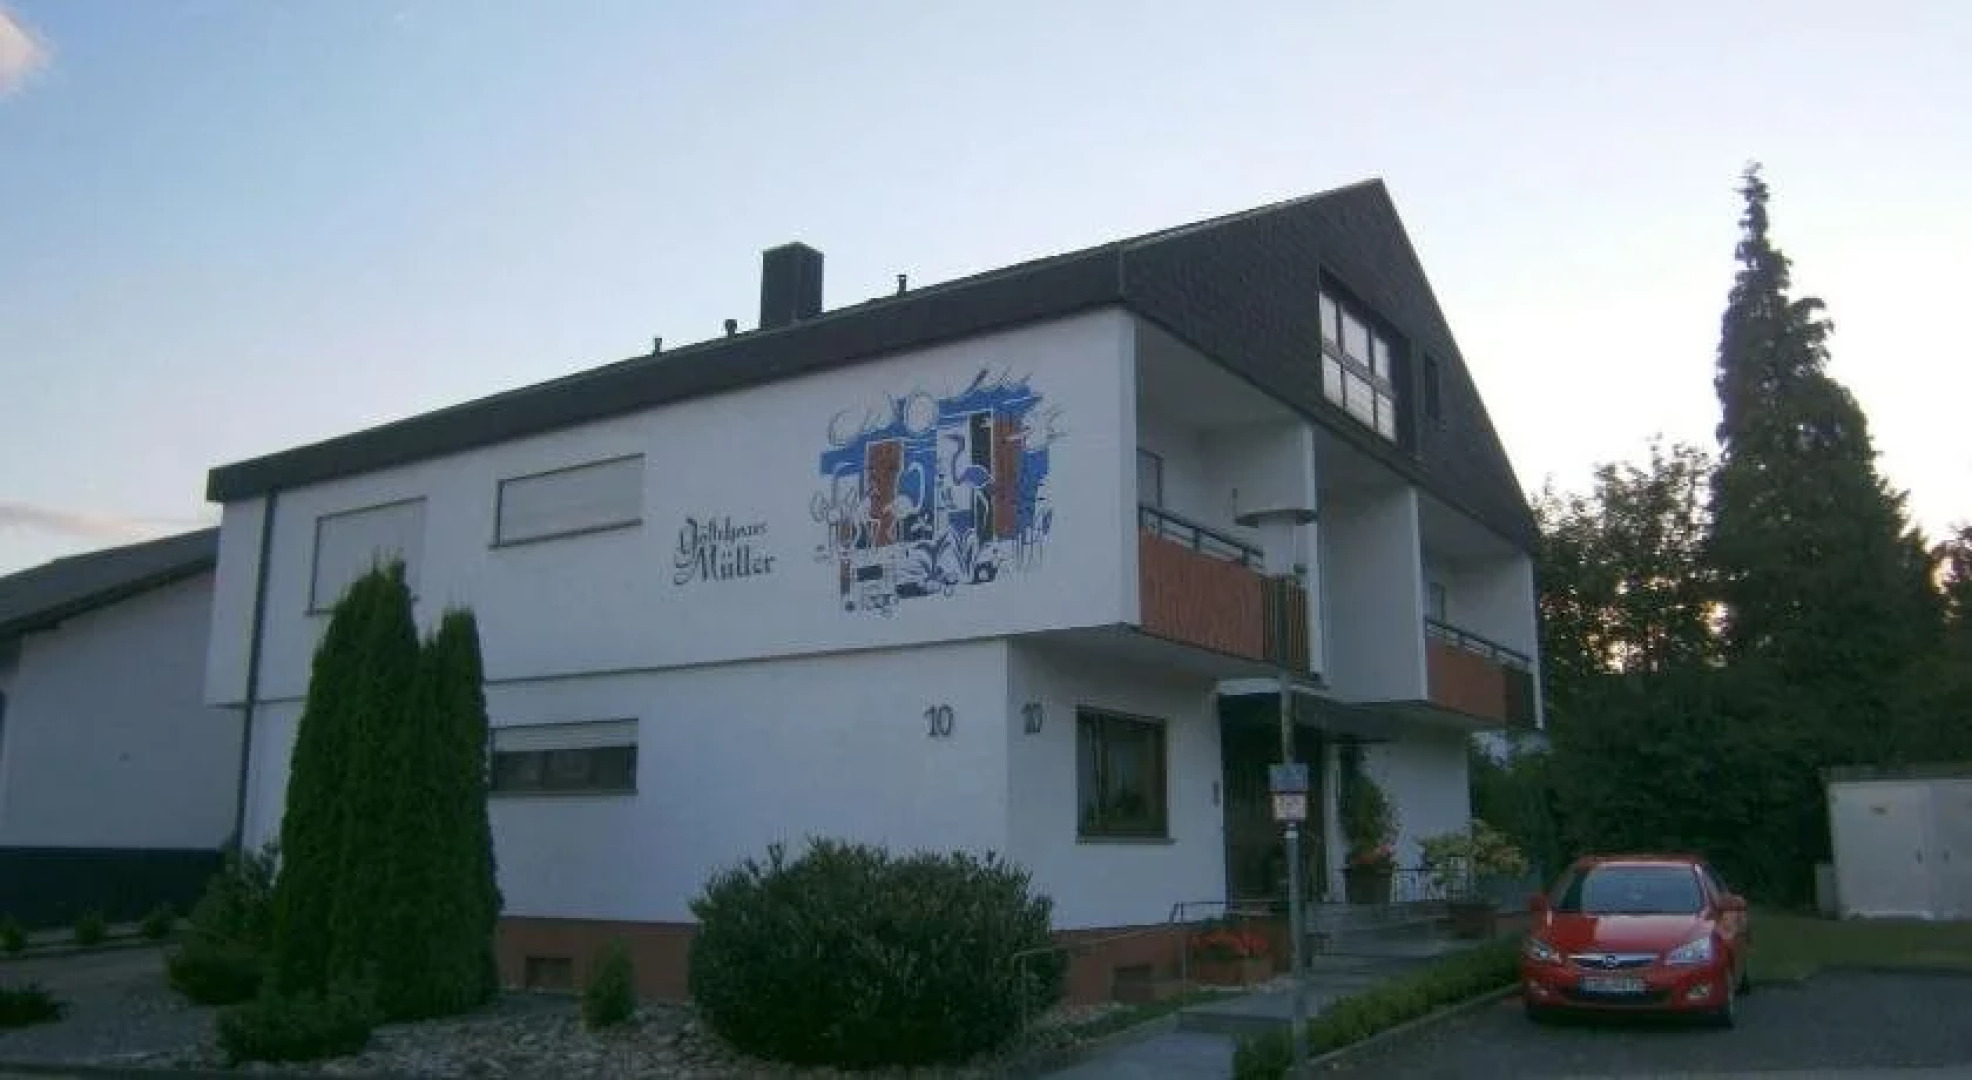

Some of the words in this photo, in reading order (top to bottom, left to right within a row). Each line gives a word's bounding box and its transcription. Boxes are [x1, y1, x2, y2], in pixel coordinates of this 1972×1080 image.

[674, 544, 776, 585] Müller
[924, 704, 953, 737] 10
[1021, 702, 1042, 735] 10
